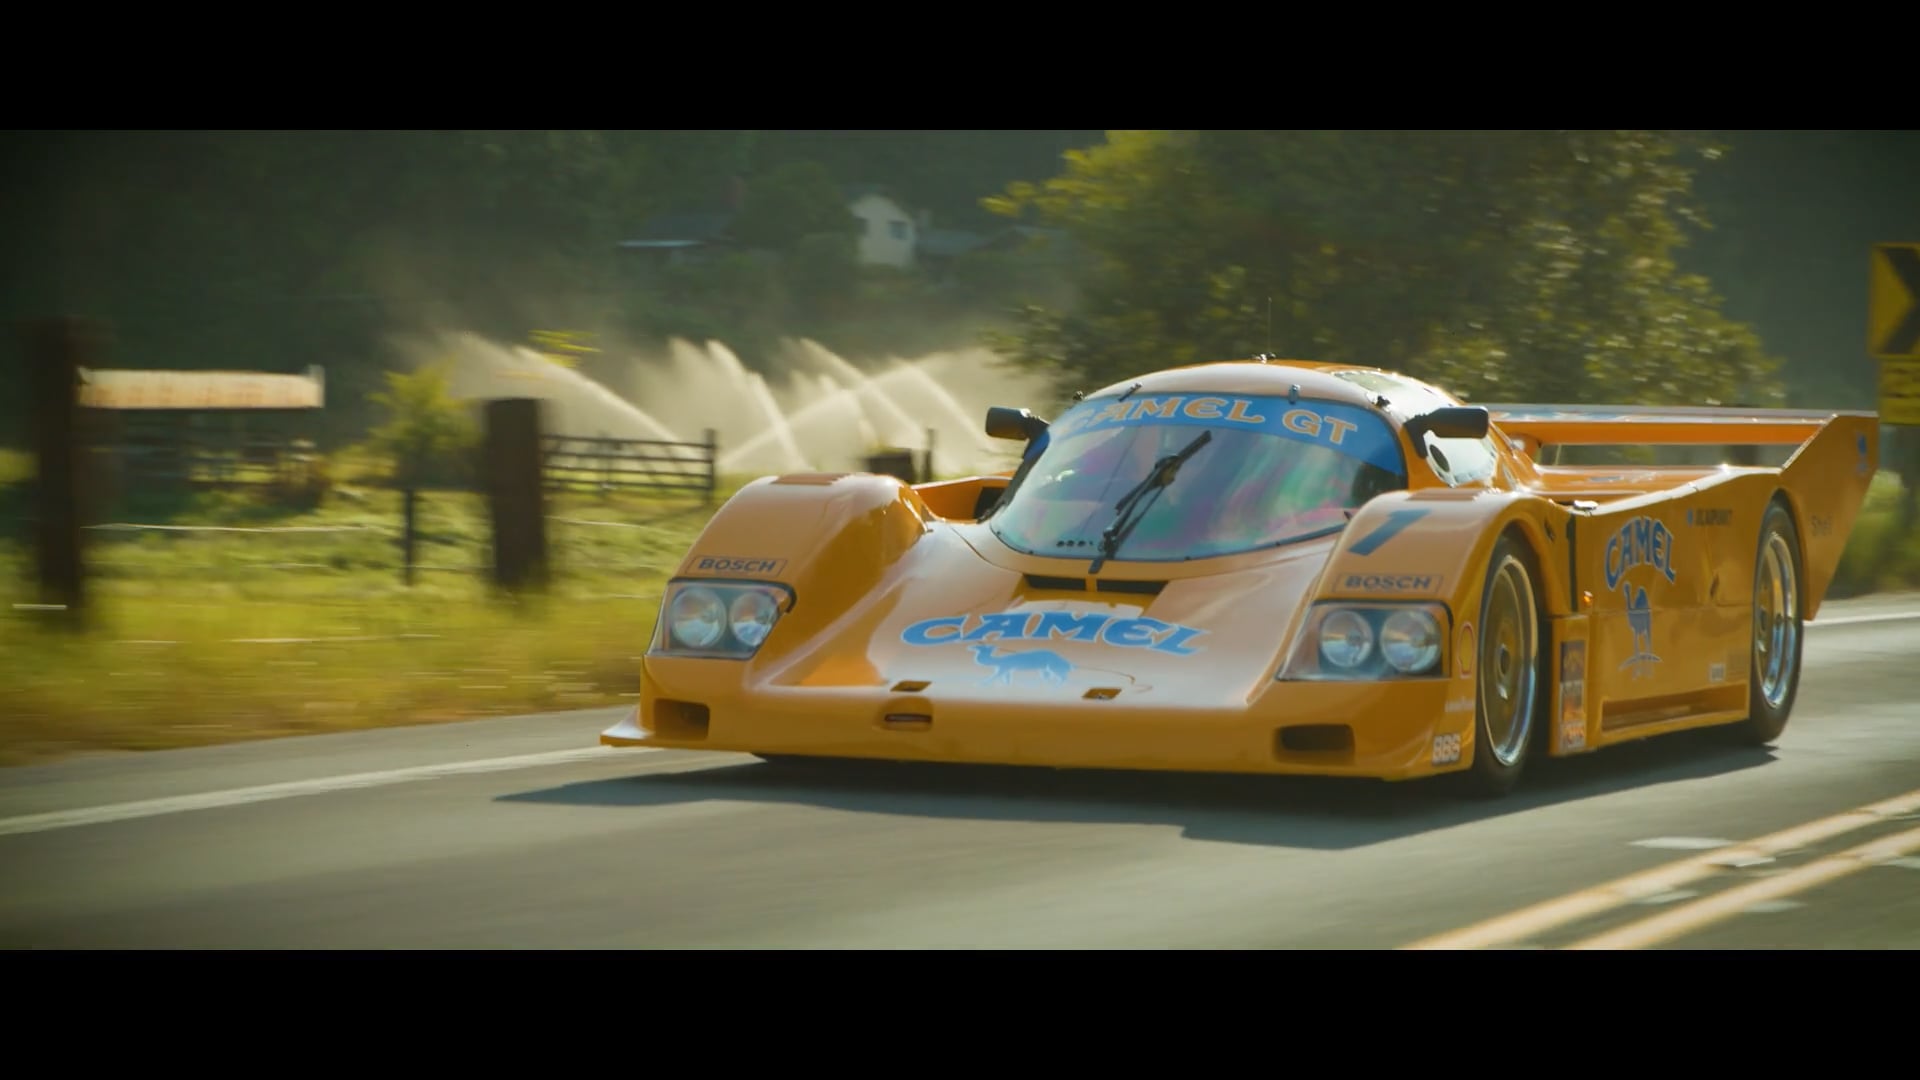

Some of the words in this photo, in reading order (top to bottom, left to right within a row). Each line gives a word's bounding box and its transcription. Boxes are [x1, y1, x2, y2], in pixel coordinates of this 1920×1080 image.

[1055, 397, 1265, 436] CAMEL
[1283, 409, 1358, 445] GT
[1346, 508, 1431, 556] 1
[1605, 516, 1677, 592] CAMEL
[698, 558, 776, 573] BOSCH
[1345, 575, 1431, 590] BOSCH
[901, 611, 1209, 655] CAMEL
